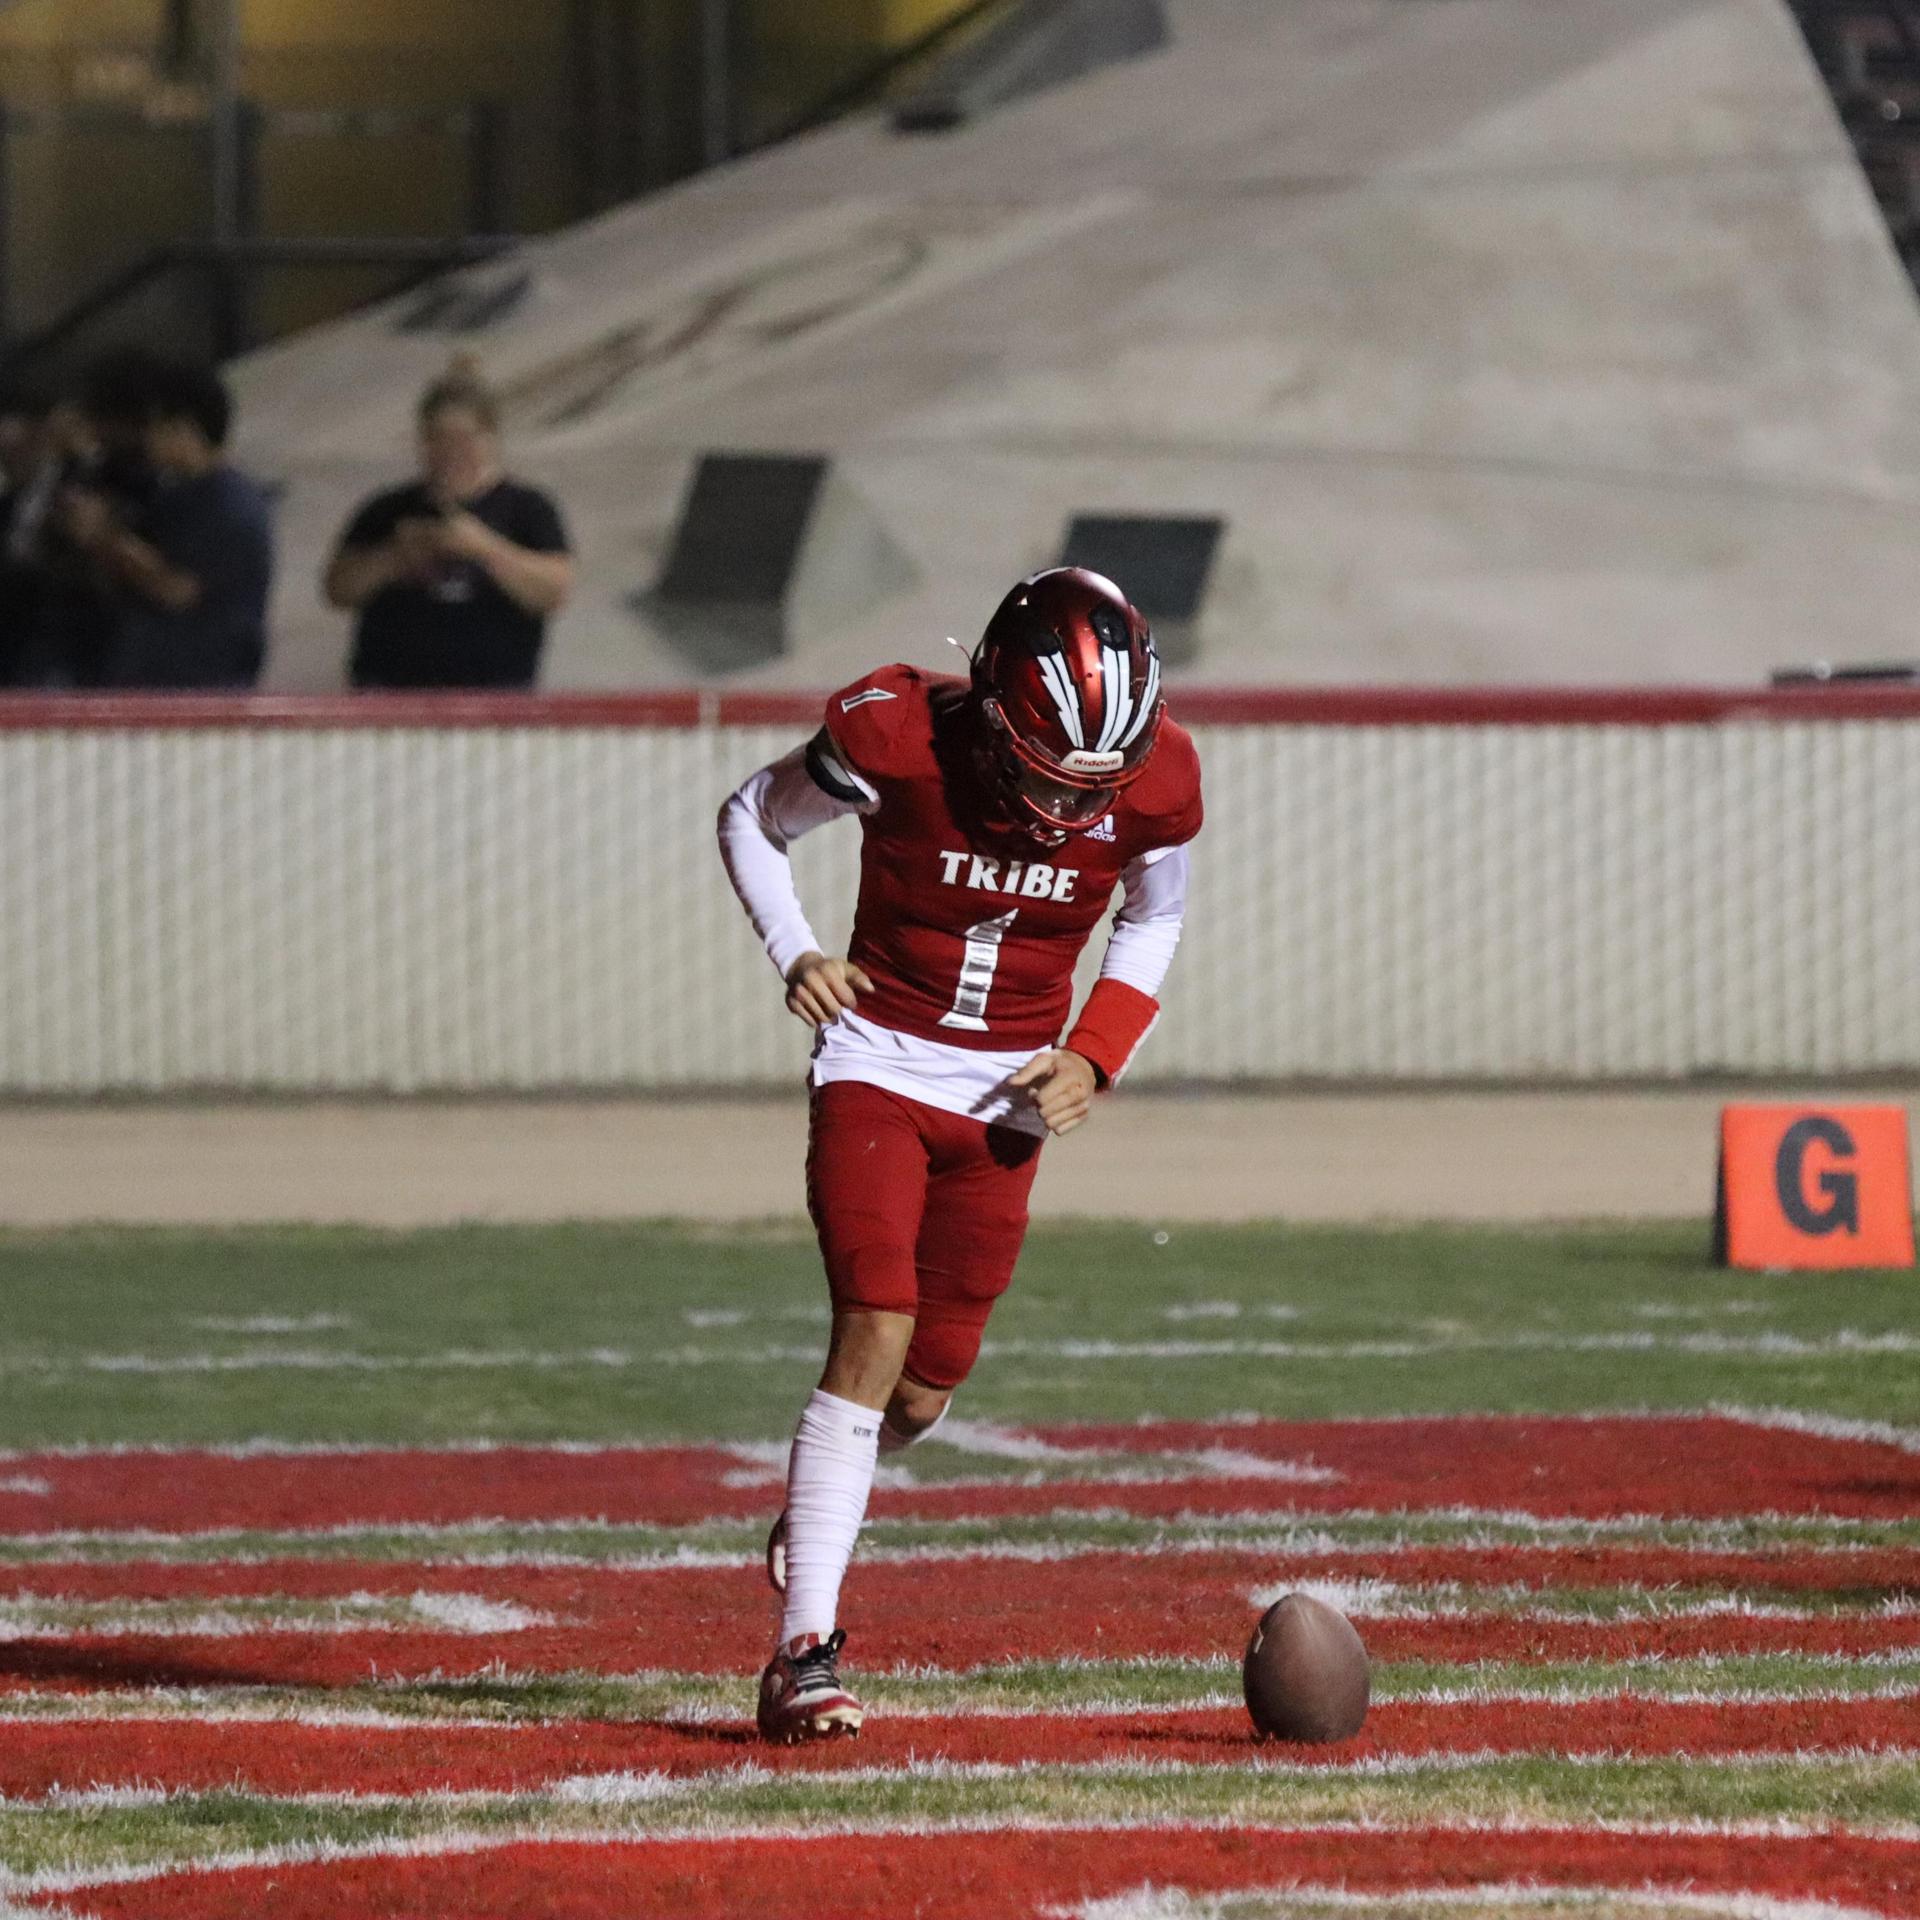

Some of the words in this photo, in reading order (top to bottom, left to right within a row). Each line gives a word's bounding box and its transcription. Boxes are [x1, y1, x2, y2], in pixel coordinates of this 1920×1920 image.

[939, 850, 1080, 903] TRIBE
[937, 908, 1019, 1031] 1
[1776, 1117, 1857, 1236] G
